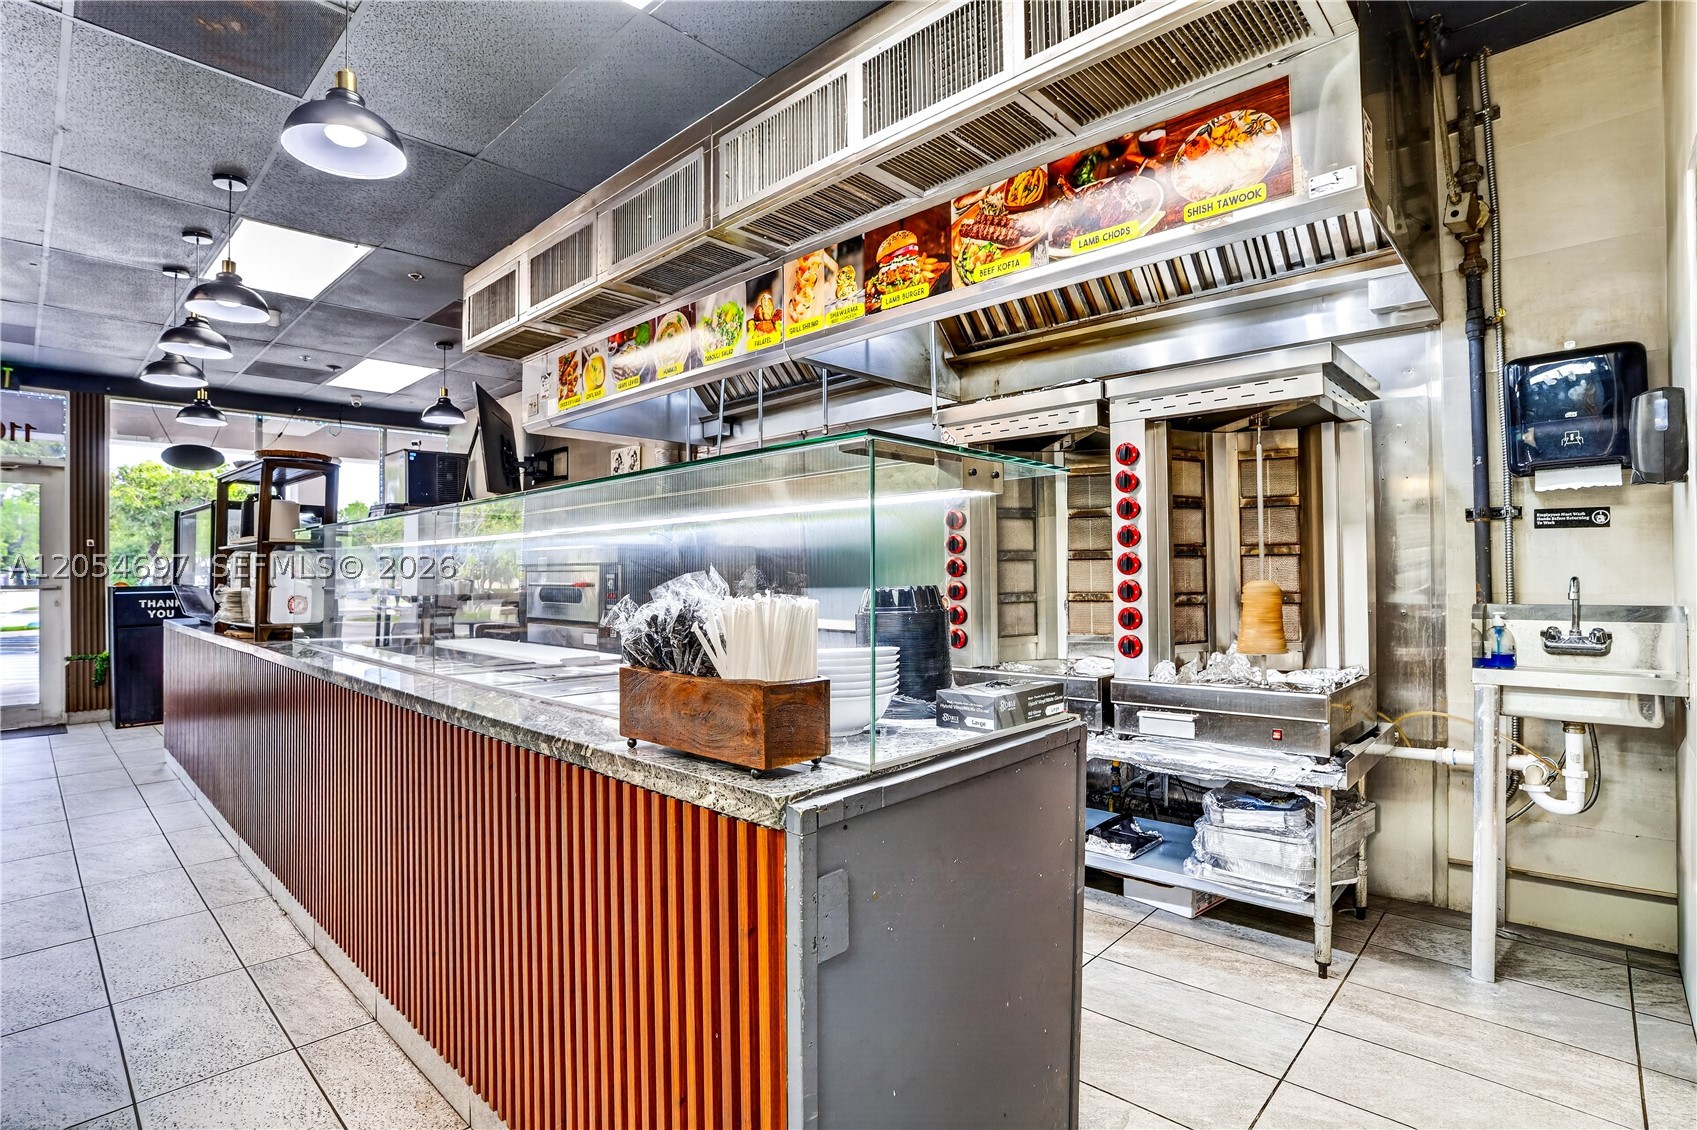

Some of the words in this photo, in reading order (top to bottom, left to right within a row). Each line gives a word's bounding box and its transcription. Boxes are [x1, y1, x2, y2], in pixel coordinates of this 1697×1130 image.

[1187, 203, 1214, 218] SHISH
[1217, 187, 1263, 209] TAWOOK
[1078, 235, 1100, 248] LAMB
[1102, 226, 1131, 241] CHOPS
[979, 266, 995, 277] BEEF
[997, 259, 1020, 272] KOFTA
[885, 294, 901, 305] LAMB
[902, 287, 925, 300] BURGER
[829, 305, 859, 319] SHAWARMA
[147, 609, 175, 619] YOU
[971, 719, 986, 727] Large
